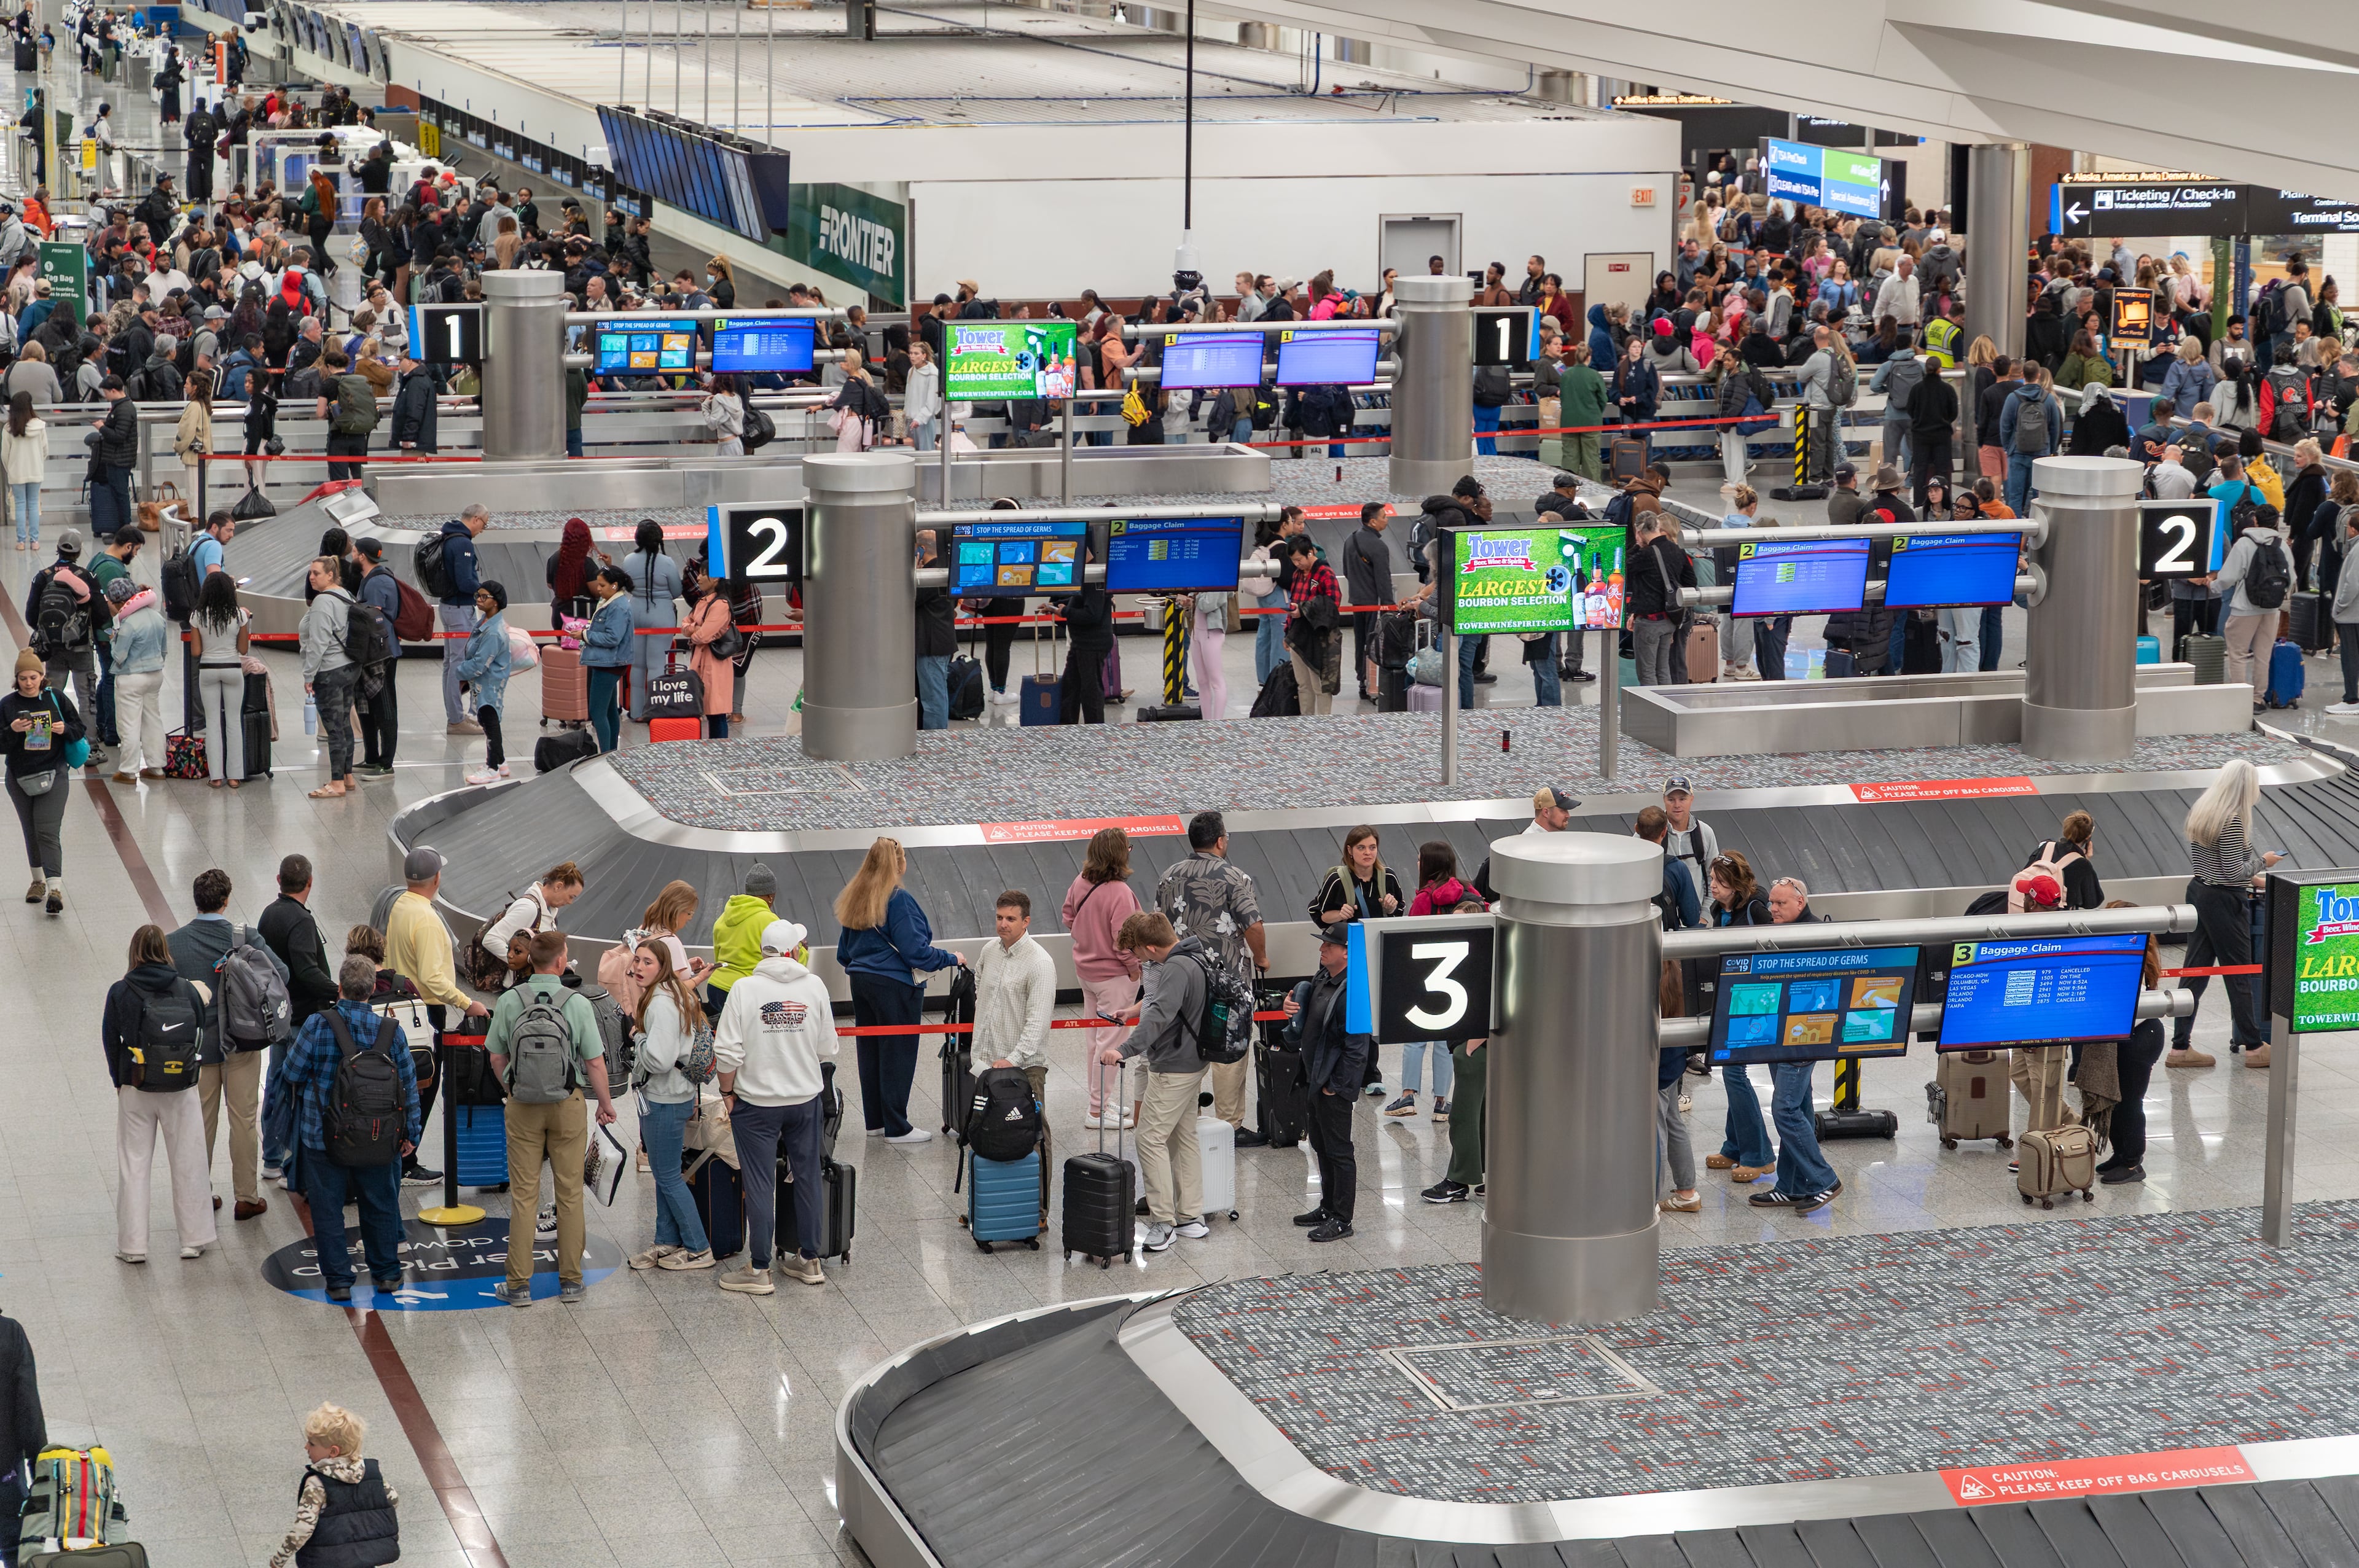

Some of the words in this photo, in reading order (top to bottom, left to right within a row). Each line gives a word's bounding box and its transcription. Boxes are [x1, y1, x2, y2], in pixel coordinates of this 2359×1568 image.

[1635, 189, 1653, 203] EXIT
[2114, 189, 2170, 202] Ticketing
[2182, 189, 2236, 200] Check-In
[2293, 211, 2342, 224] Terminal
[819, 205, 894, 277] FRONTIER
[44, 274, 58, 283] Tag
[60, 275, 74, 284] Bag
[444, 314, 461, 358] 1
[956, 326, 1004, 344] Tower
[1495, 318, 1510, 361] 1
[949, 361, 1020, 373] LARGEST
[1113, 522, 1123, 533] 2
[745, 517, 788, 576] 2
[1468, 534, 1531, 558] Tower
[1742, 545, 1752, 556] 2
[1896, 538, 1905, 549] 2
[2154, 515, 2196, 572] 2
[1458, 579, 1552, 597] LARGEST
[1458, 597, 1508, 607] BOURBON
[1511, 595, 1567, 606] SELECTION
[1458, 619, 1570, 630] TOWERWINESPIRITS.COM
[660, 679, 688, 691] love
[651, 693, 670, 705] my
[673, 692, 694, 703] life
[2323, 925, 2342, 934] Beer,
[1956, 945, 1971, 962] 3
[1981, 946, 2028, 957] Baggage
[2032, 943, 2062, 953] Claim
[1726, 958, 1749, 967] COVID
[1758, 959, 1778, 969] STOP
[1780, 958, 1795, 968] THE
[1796, 957, 1827, 967] SPREAD
[1829, 956, 1839, 965] OF
[1841, 954, 1869, 965] GERMS
[1404, 941, 1470, 1031] 3
[2300, 978, 2359, 993] BOURBO
[761, 1013, 790, 1022] CLASS
[1992, 1469, 2059, 1483] CAUTION:
[1998, 1480, 2056, 1496] PLEASE
[2057, 1478, 2094, 1491] KEEP
[2097, 1475, 2124, 1487] OFF
[2130, 1472, 2158, 1484] BAG
[2161, 1464, 2245, 1481] CAROUSELS
